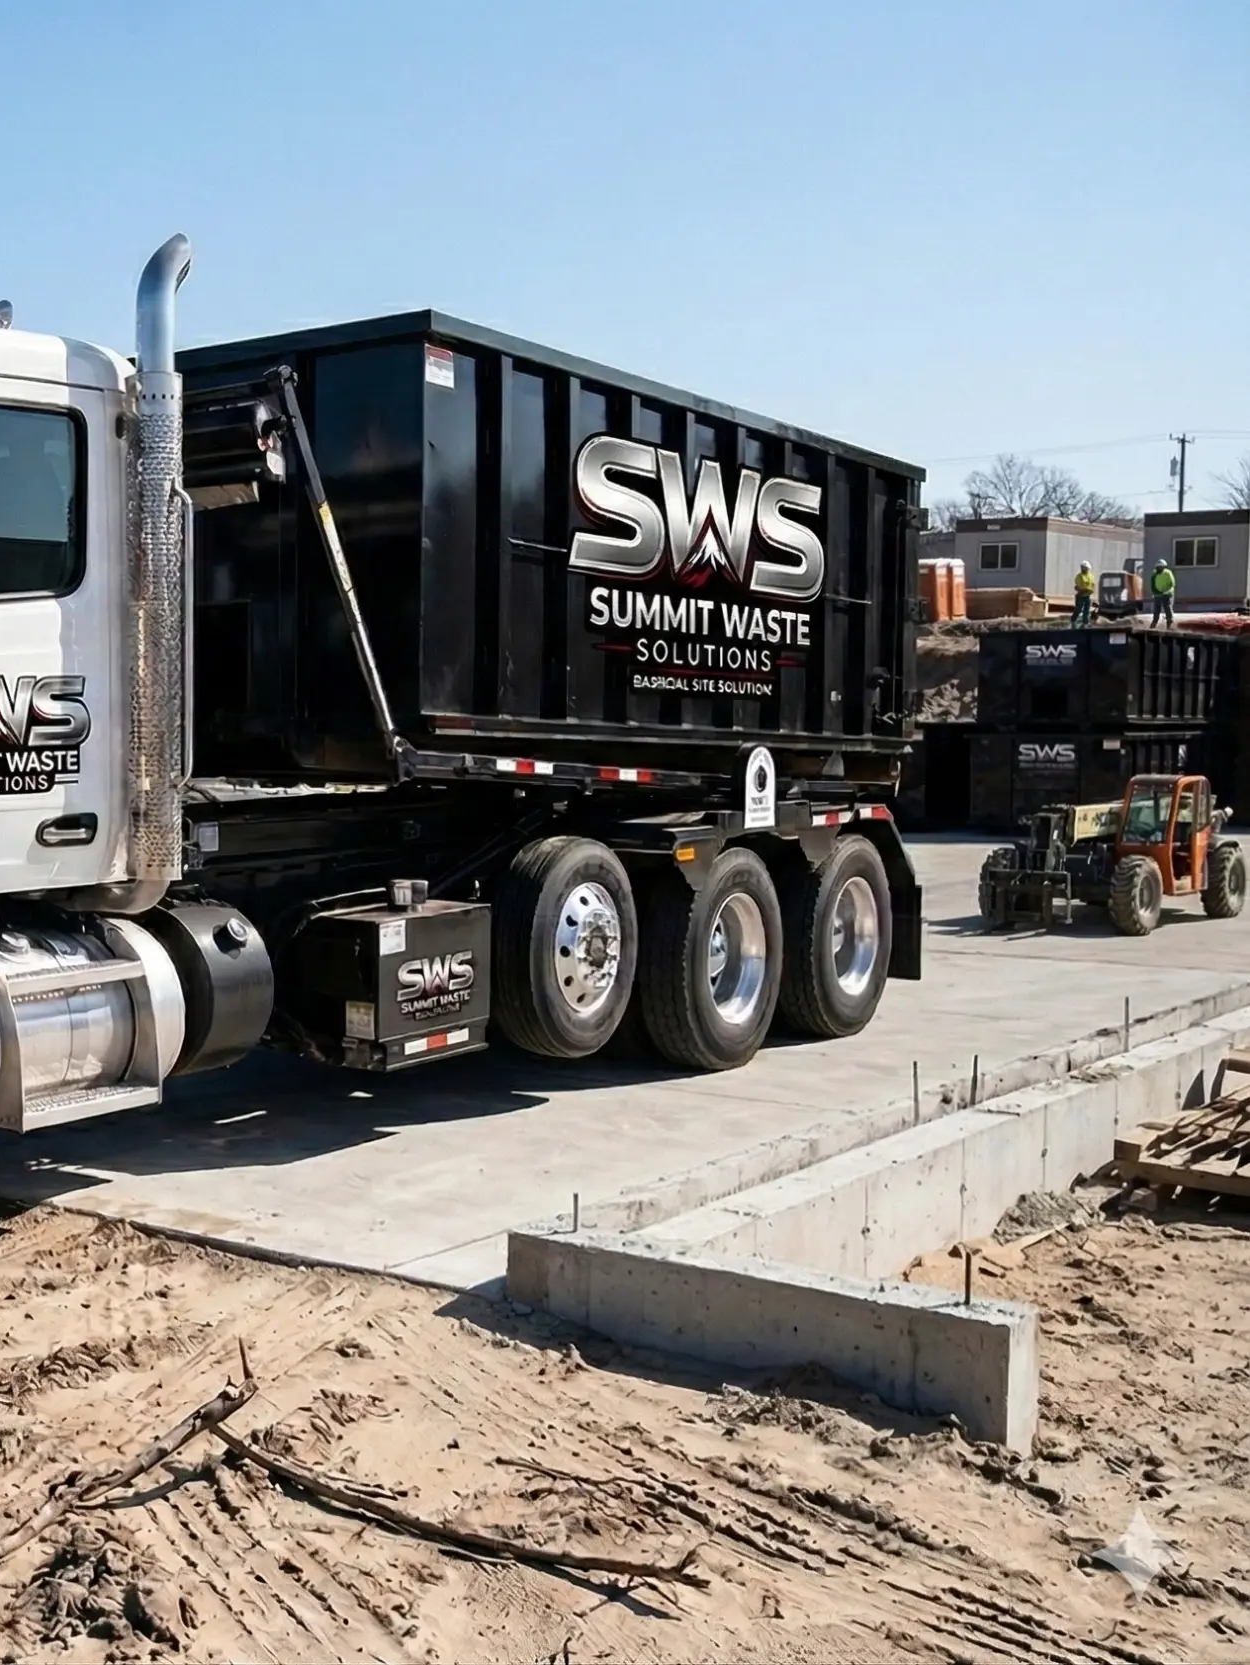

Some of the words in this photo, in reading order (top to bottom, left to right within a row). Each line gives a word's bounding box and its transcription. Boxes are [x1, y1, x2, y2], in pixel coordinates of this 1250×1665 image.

[568, 434, 825, 602] SWS
[590, 586, 714, 634] SUMMIT
[721, 603, 811, 646] WASTE
[636, 638, 772, 672] SOLUTIONS
[1025, 644, 1077, 658] SWS
[692, 678, 716, 693] SITE
[6, 750, 78, 773] WASTE
[1017, 744, 1075, 762] SWS
[397, 951, 474, 1001] SWS
